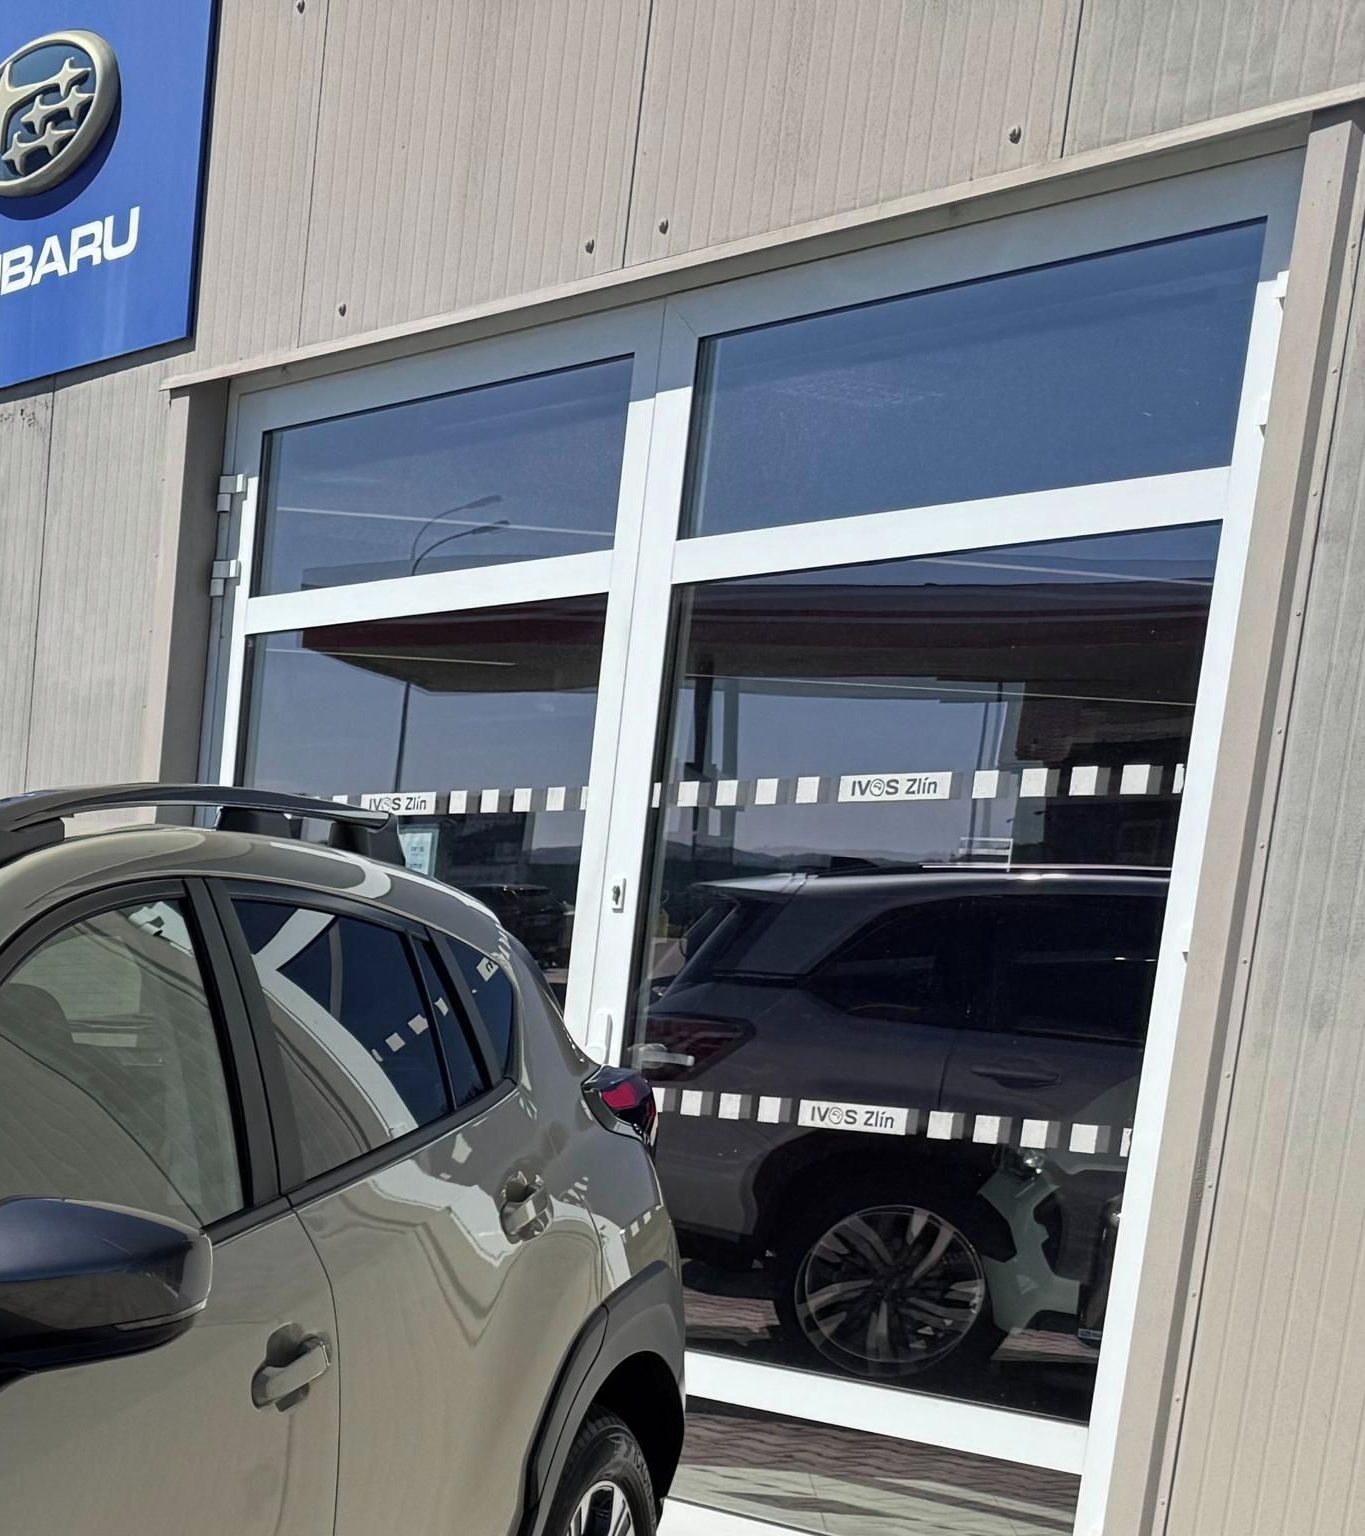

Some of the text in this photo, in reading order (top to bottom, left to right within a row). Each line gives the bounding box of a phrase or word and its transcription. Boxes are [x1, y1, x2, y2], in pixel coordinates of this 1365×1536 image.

[851, 777, 938, 797] IVOS Zlín
[405, 796, 427, 811] Zlín
[810, 1106, 896, 1129] IVOS Zlín
